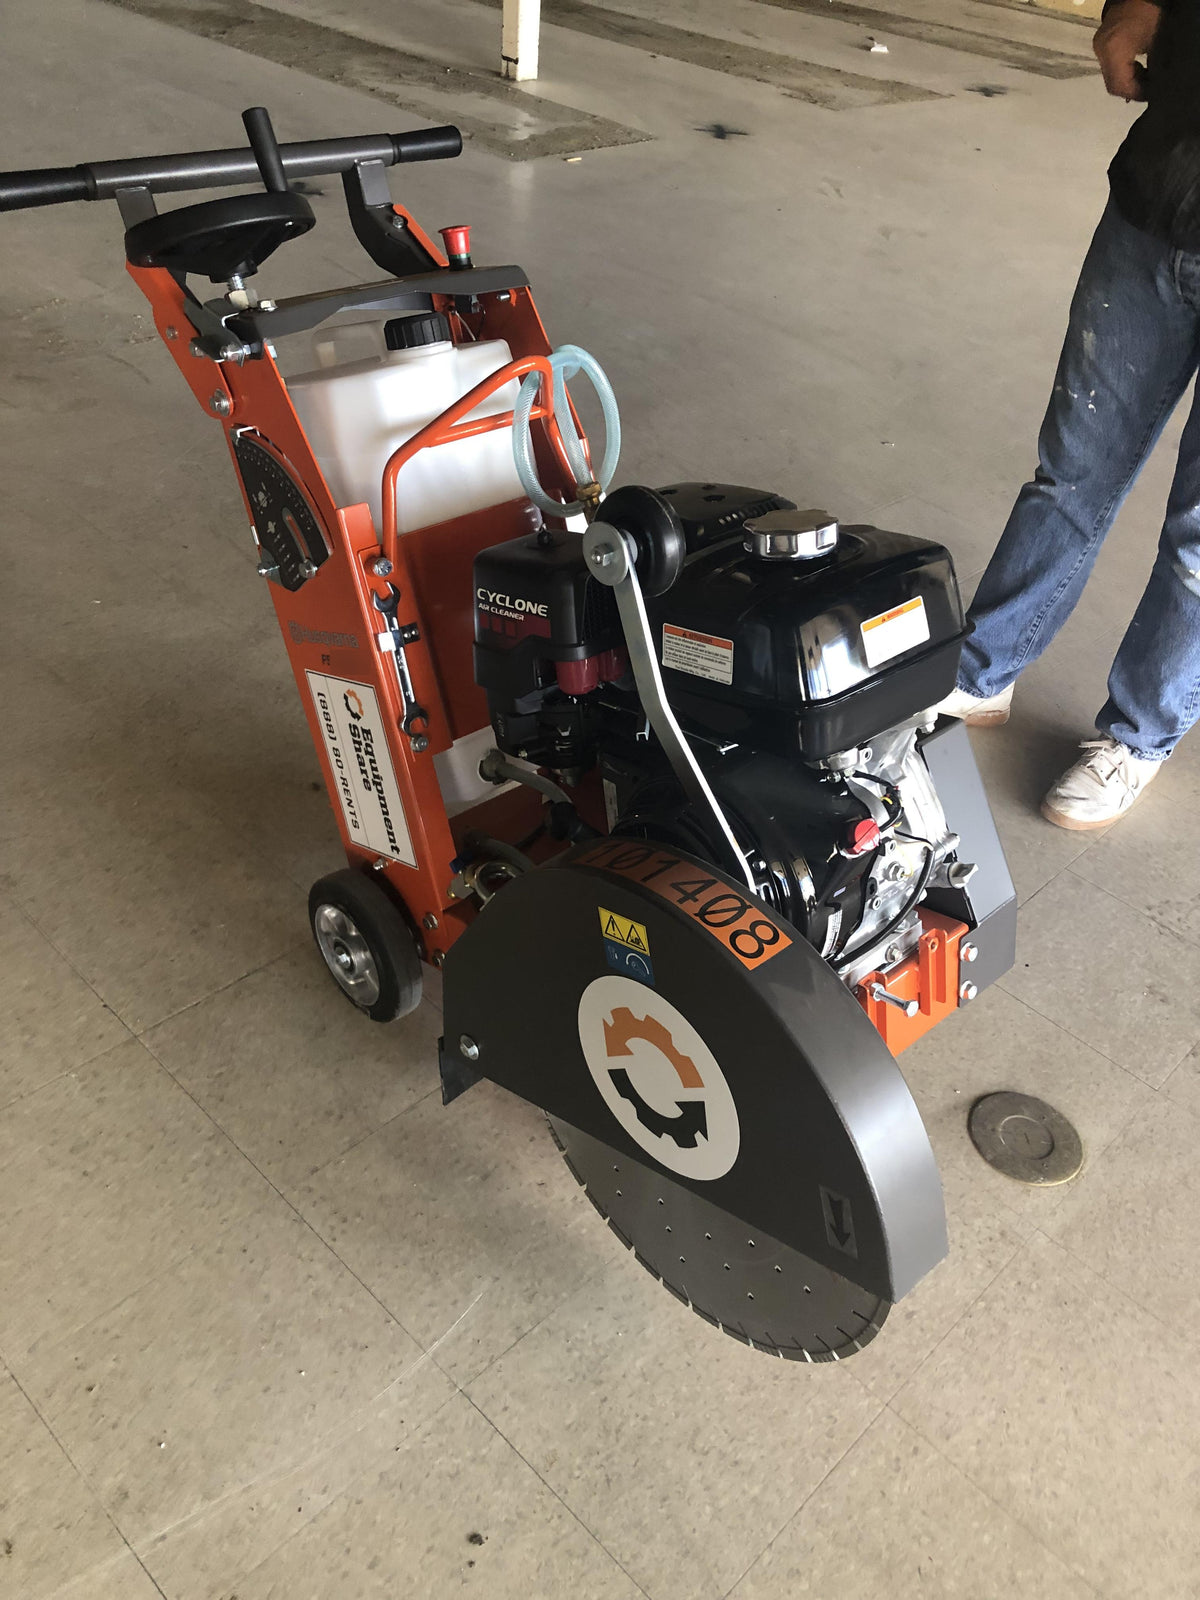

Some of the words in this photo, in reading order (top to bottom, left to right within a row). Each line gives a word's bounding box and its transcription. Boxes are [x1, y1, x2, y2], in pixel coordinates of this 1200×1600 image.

[476, 587, 549, 617] CYCLONE
[478, 602, 490, 611] AIR
[490, 607, 525, 622] CLEANER
[317, 691, 337, 742] (888)
[332, 746, 360, 830] 80-RENTS
[348, 722, 372, 792] Share
[360, 725, 401, 855] Equipment
